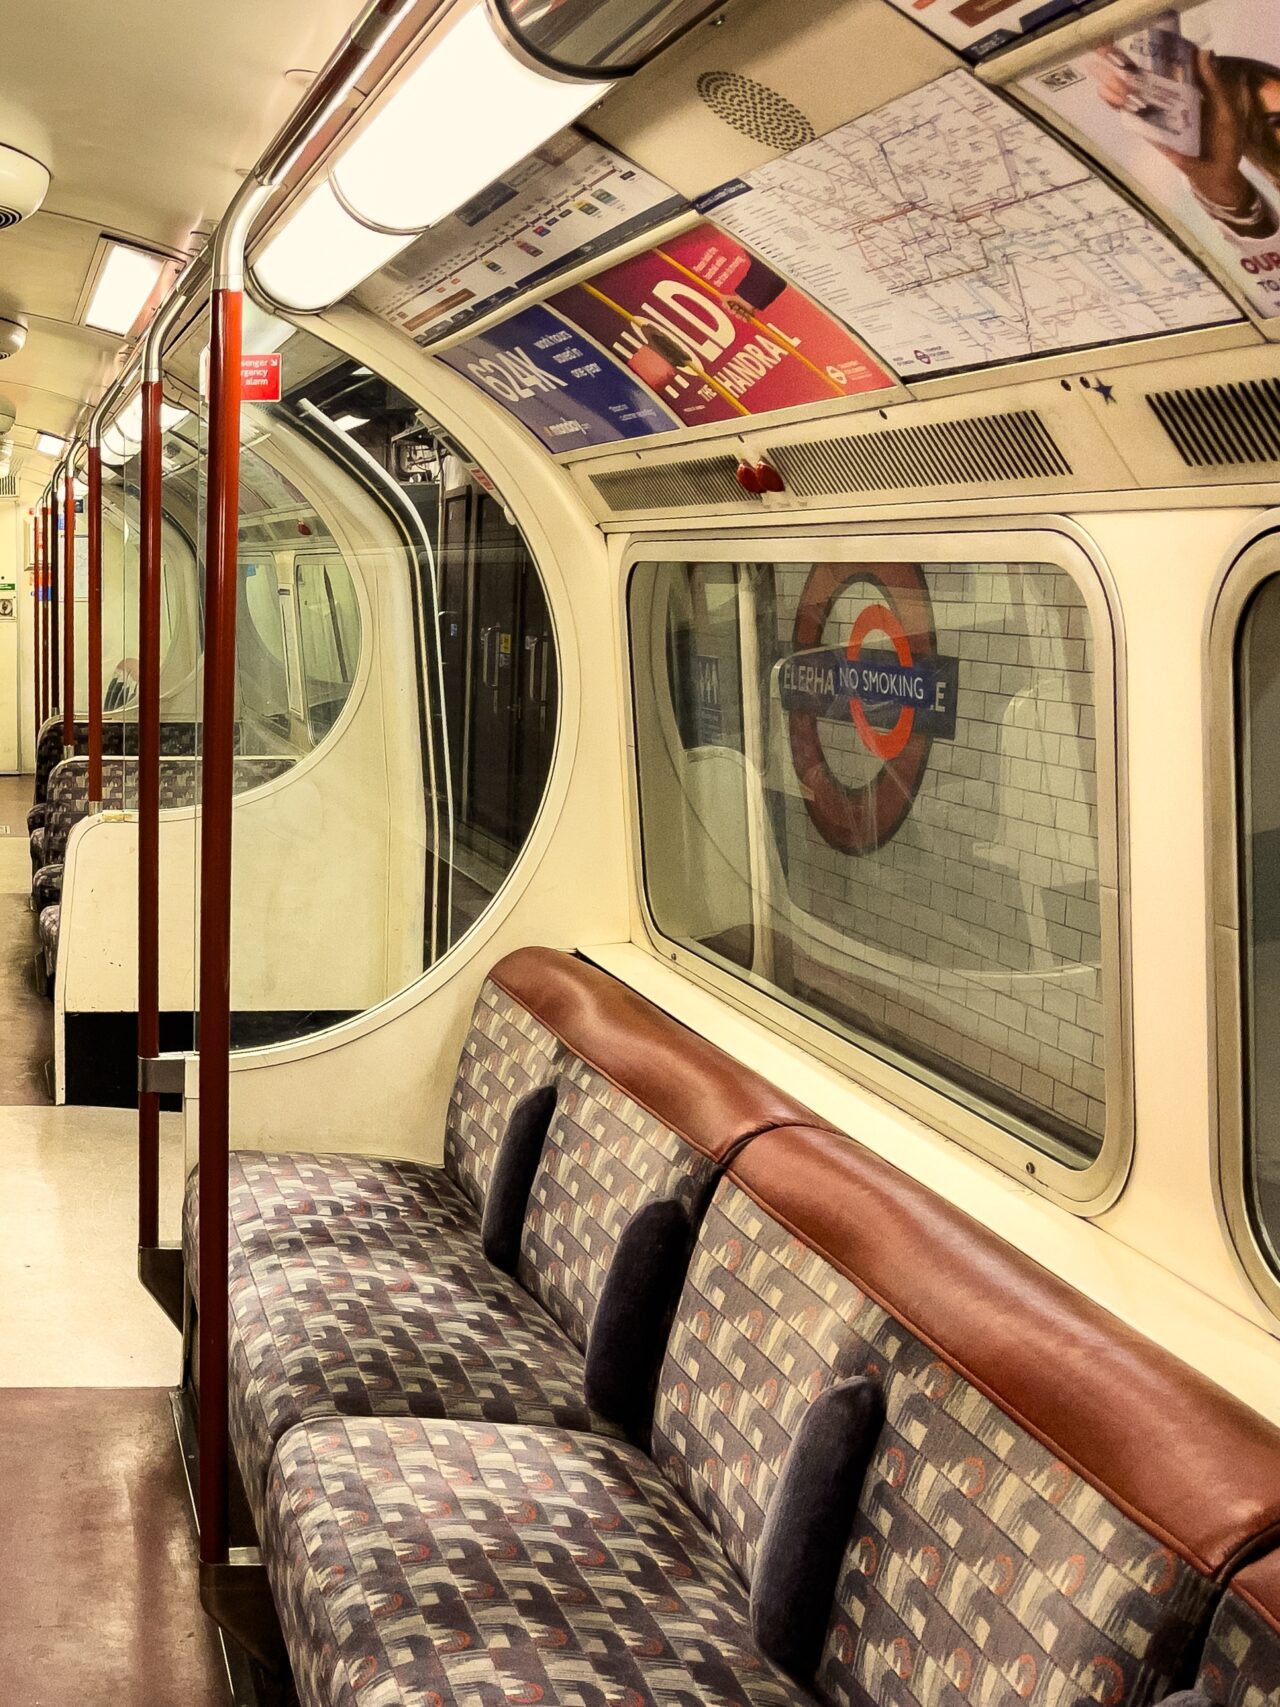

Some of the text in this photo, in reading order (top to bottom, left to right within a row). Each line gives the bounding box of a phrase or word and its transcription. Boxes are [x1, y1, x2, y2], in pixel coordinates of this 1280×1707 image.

[240, 360, 269, 368] senger
[240, 369, 269, 378] rgency
[245, 377, 269, 386] alarm
[467, 346, 568, 402] 624K
[697, 384, 718, 402] THE
[783, 664, 835, 696] ELEPHA
[839, 666, 859, 690] NO
[862, 669, 924, 700] SMOKING
